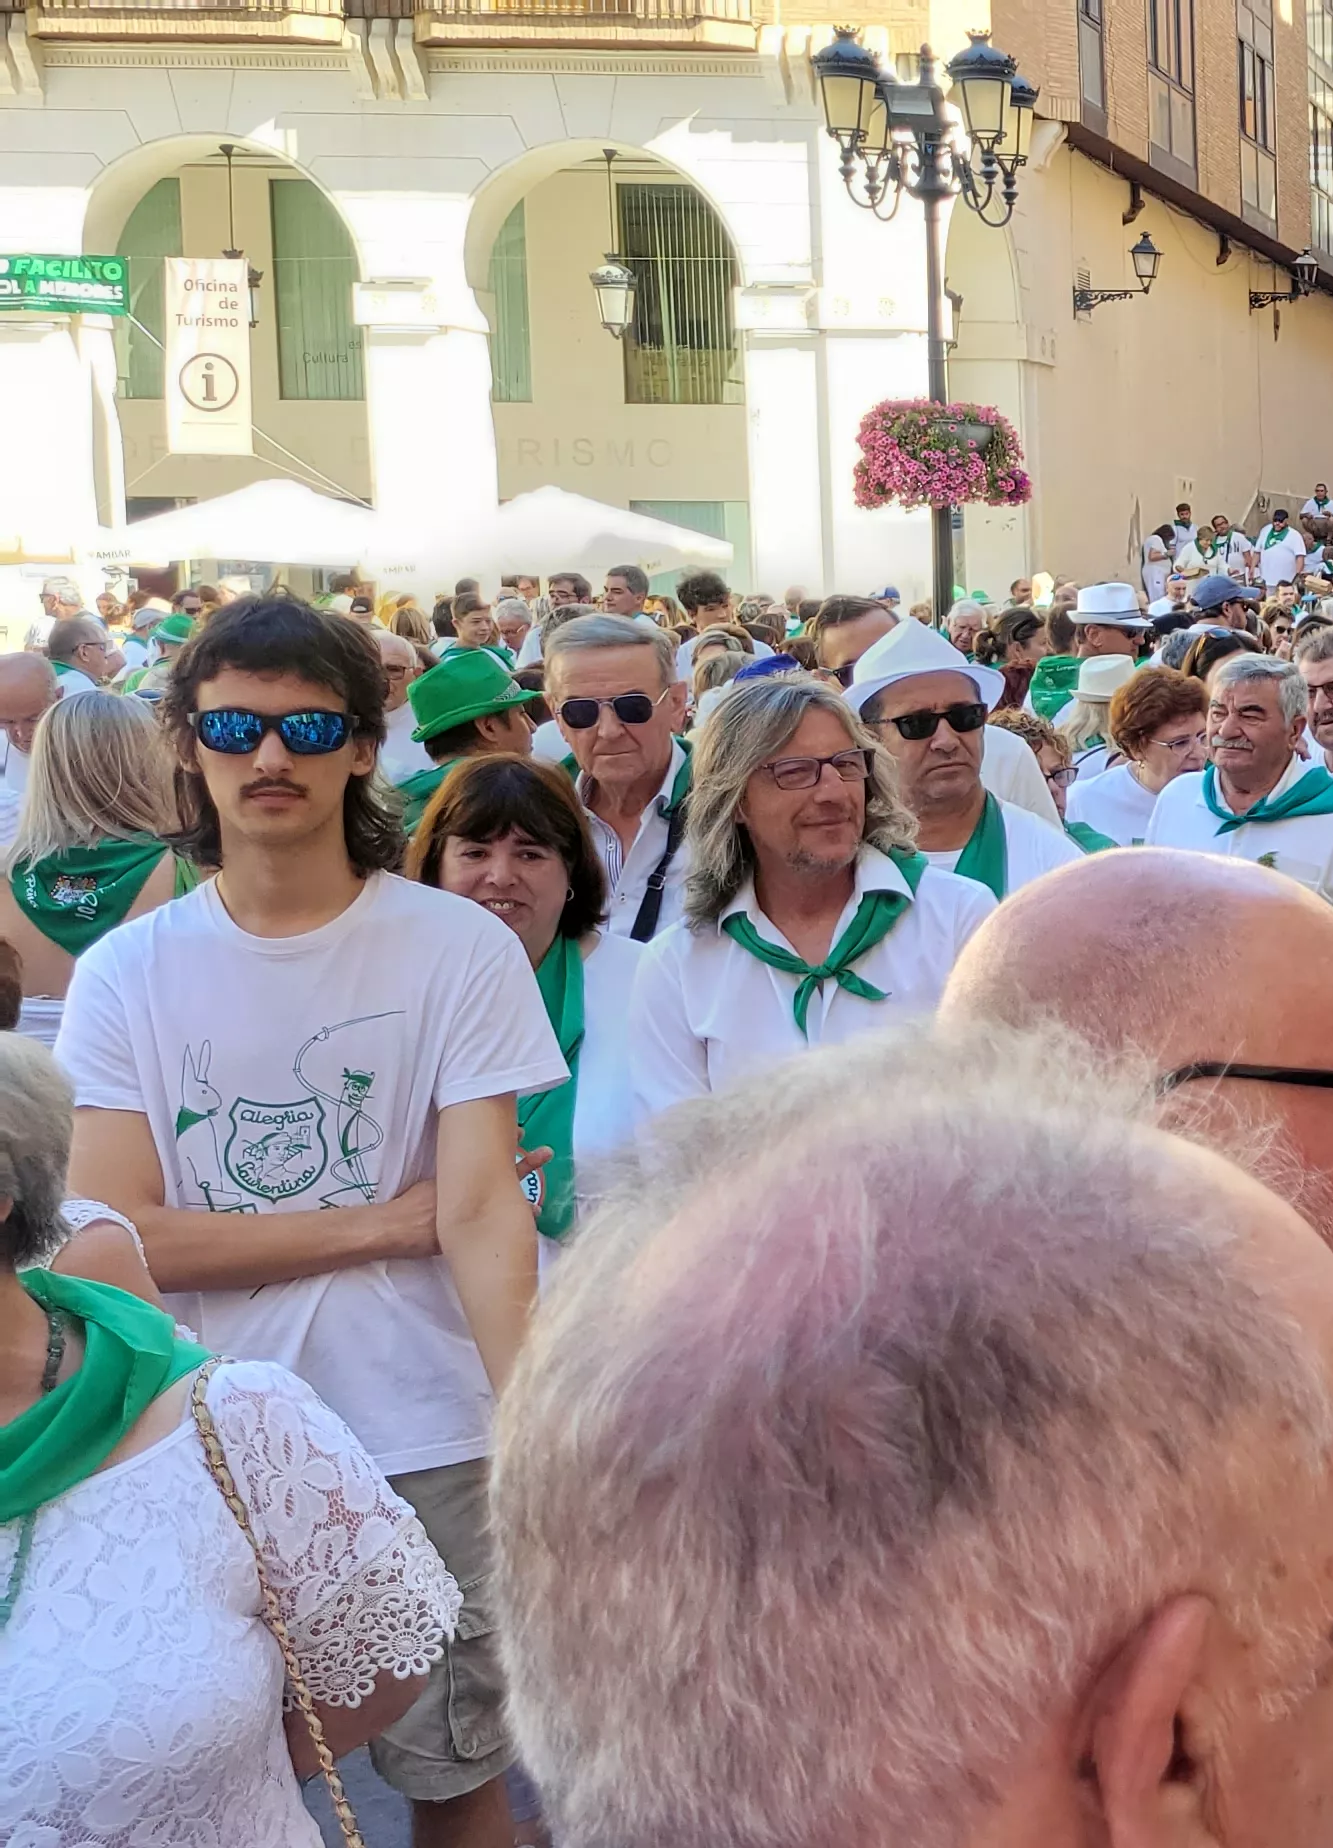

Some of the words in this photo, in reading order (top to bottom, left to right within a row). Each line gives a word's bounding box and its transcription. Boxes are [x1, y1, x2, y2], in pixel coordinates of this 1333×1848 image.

[183, 278, 239, 293] Oficina
[218, 296, 240, 310] de
[175, 313, 239, 328] Turismo
[240, 1109, 315, 1131] Alegria
